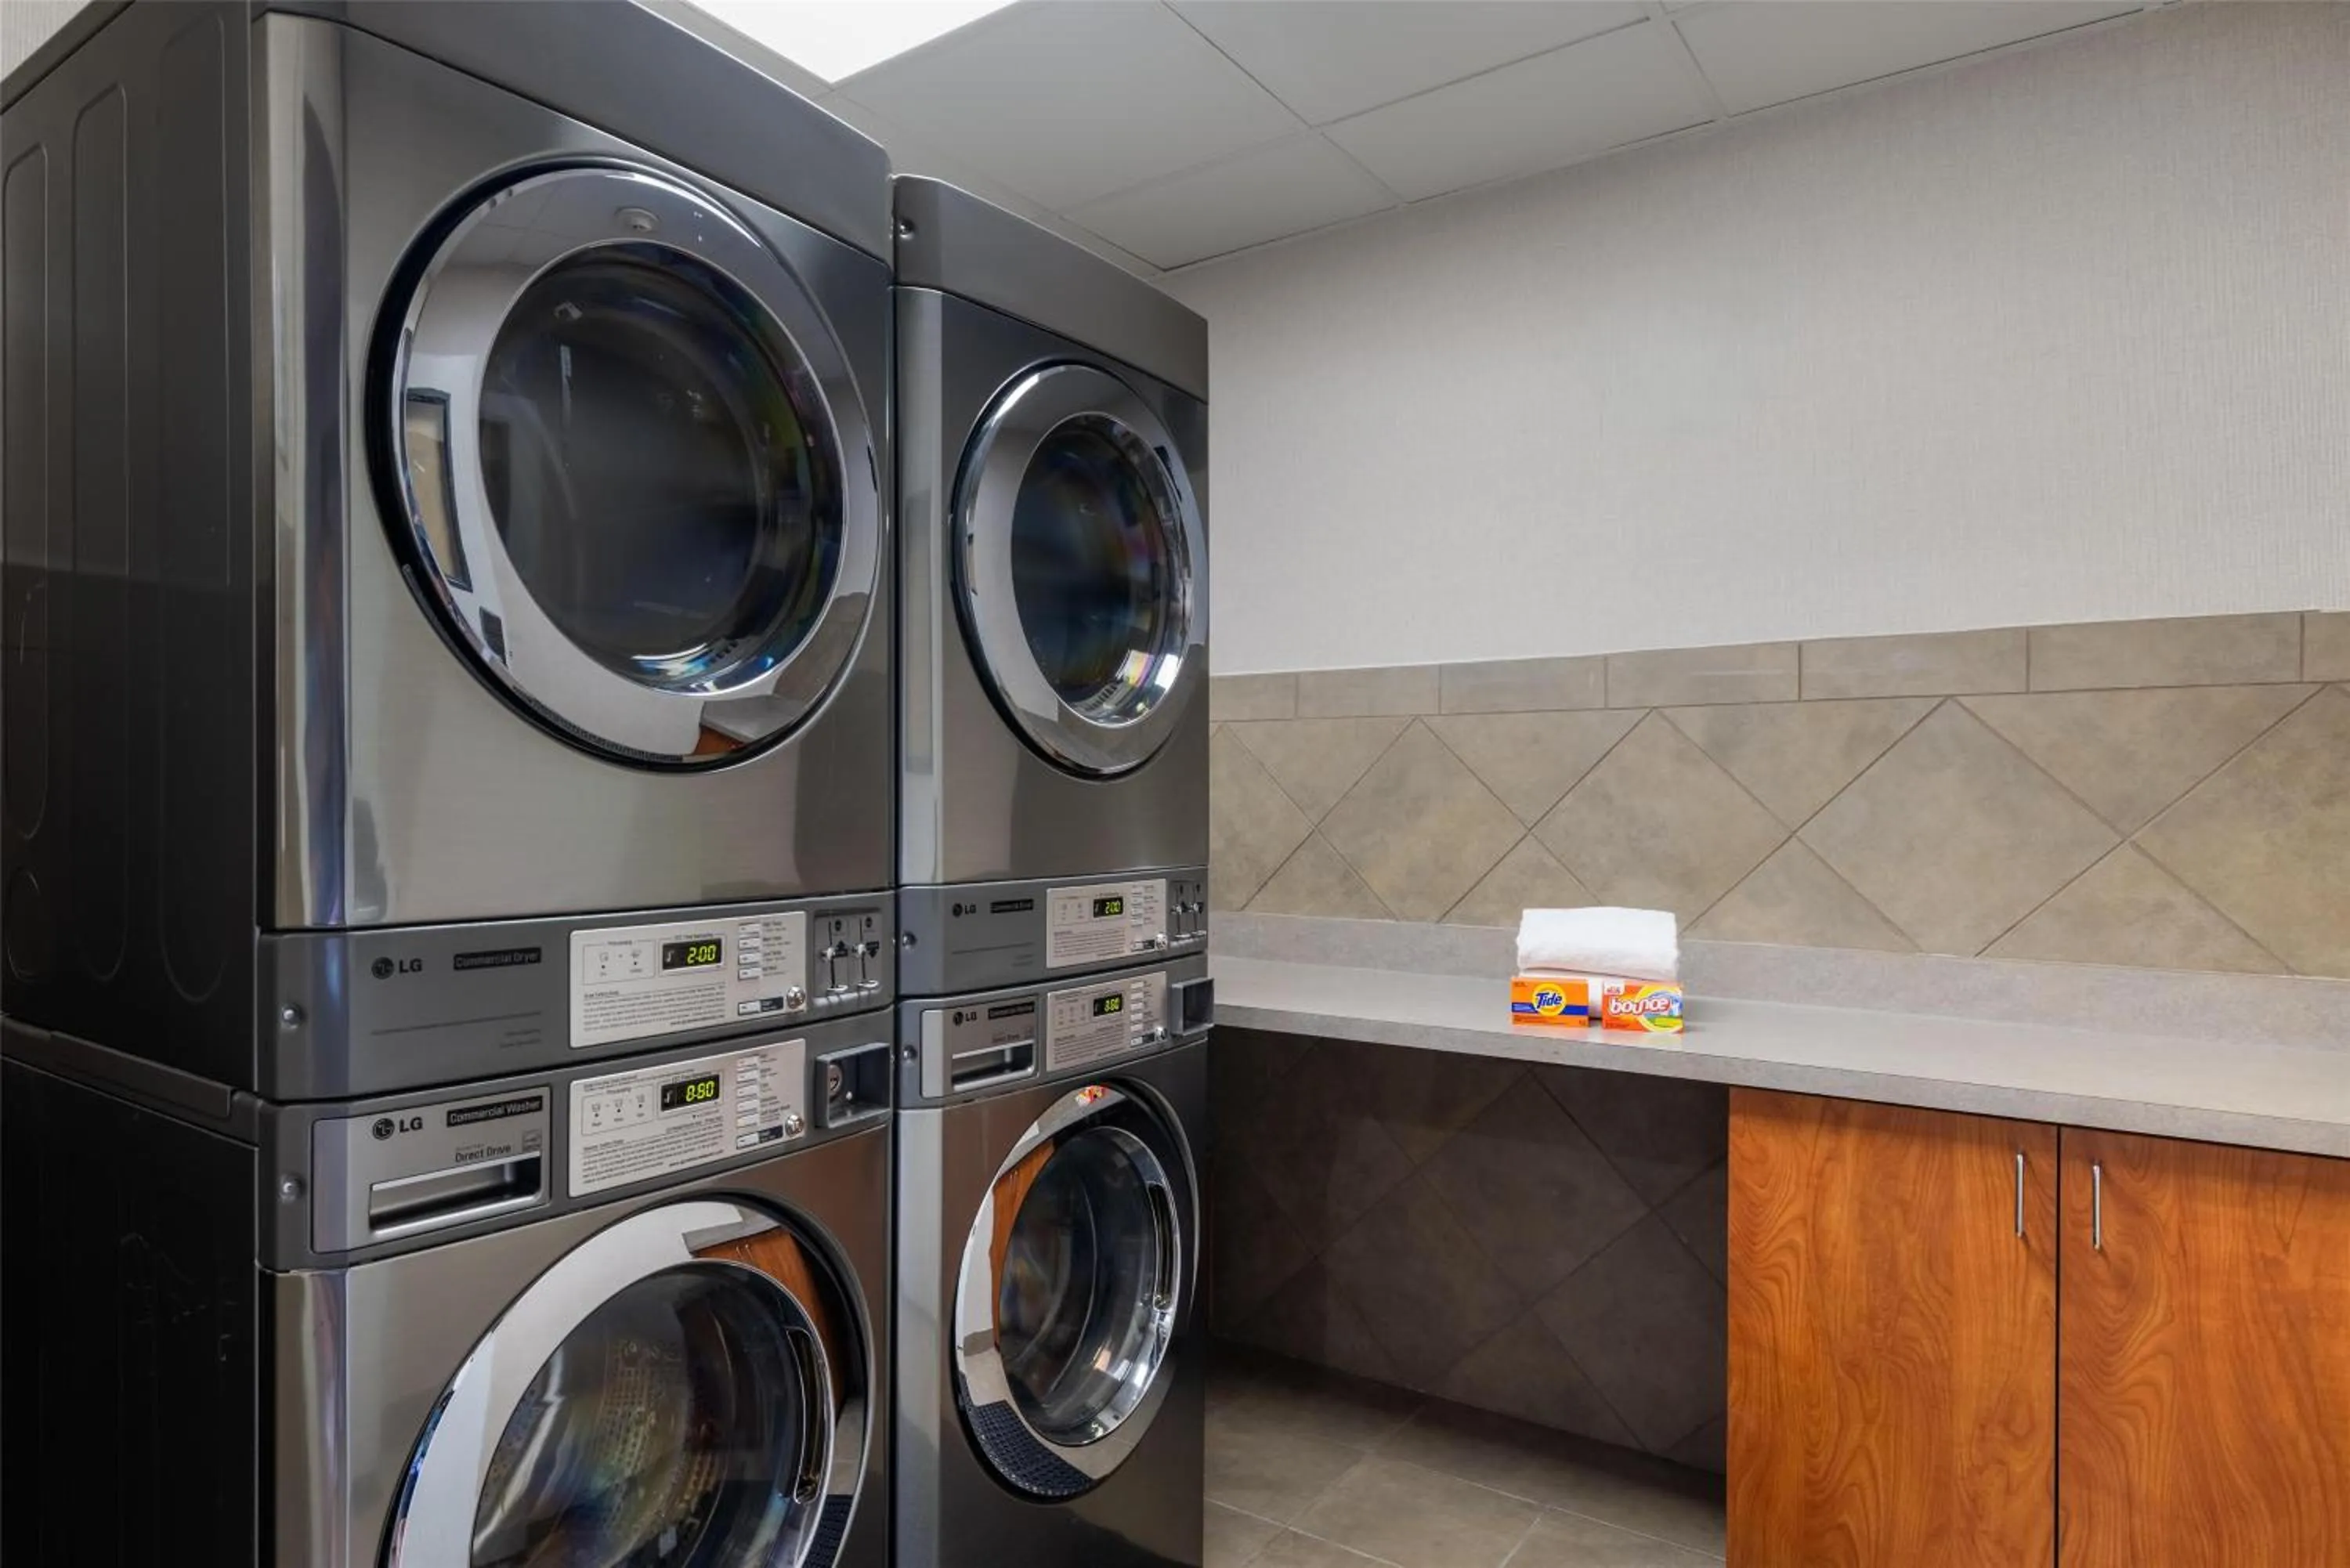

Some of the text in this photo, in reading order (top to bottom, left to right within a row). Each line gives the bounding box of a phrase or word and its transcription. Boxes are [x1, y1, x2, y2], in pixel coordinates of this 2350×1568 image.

[964, 904, 976, 914] LG
[399, 958, 423, 974] LG
[455, 954, 512, 967] Commercial
[1535, 992, 1563, 1009] Tide
[965, 1011, 977, 1021] LG
[450, 1100, 540, 1123] Commercial Washer
[399, 1117, 423, 1133] LG
[455, 1149, 484, 1162] Direct
[486, 1144, 512, 1157] Drive
